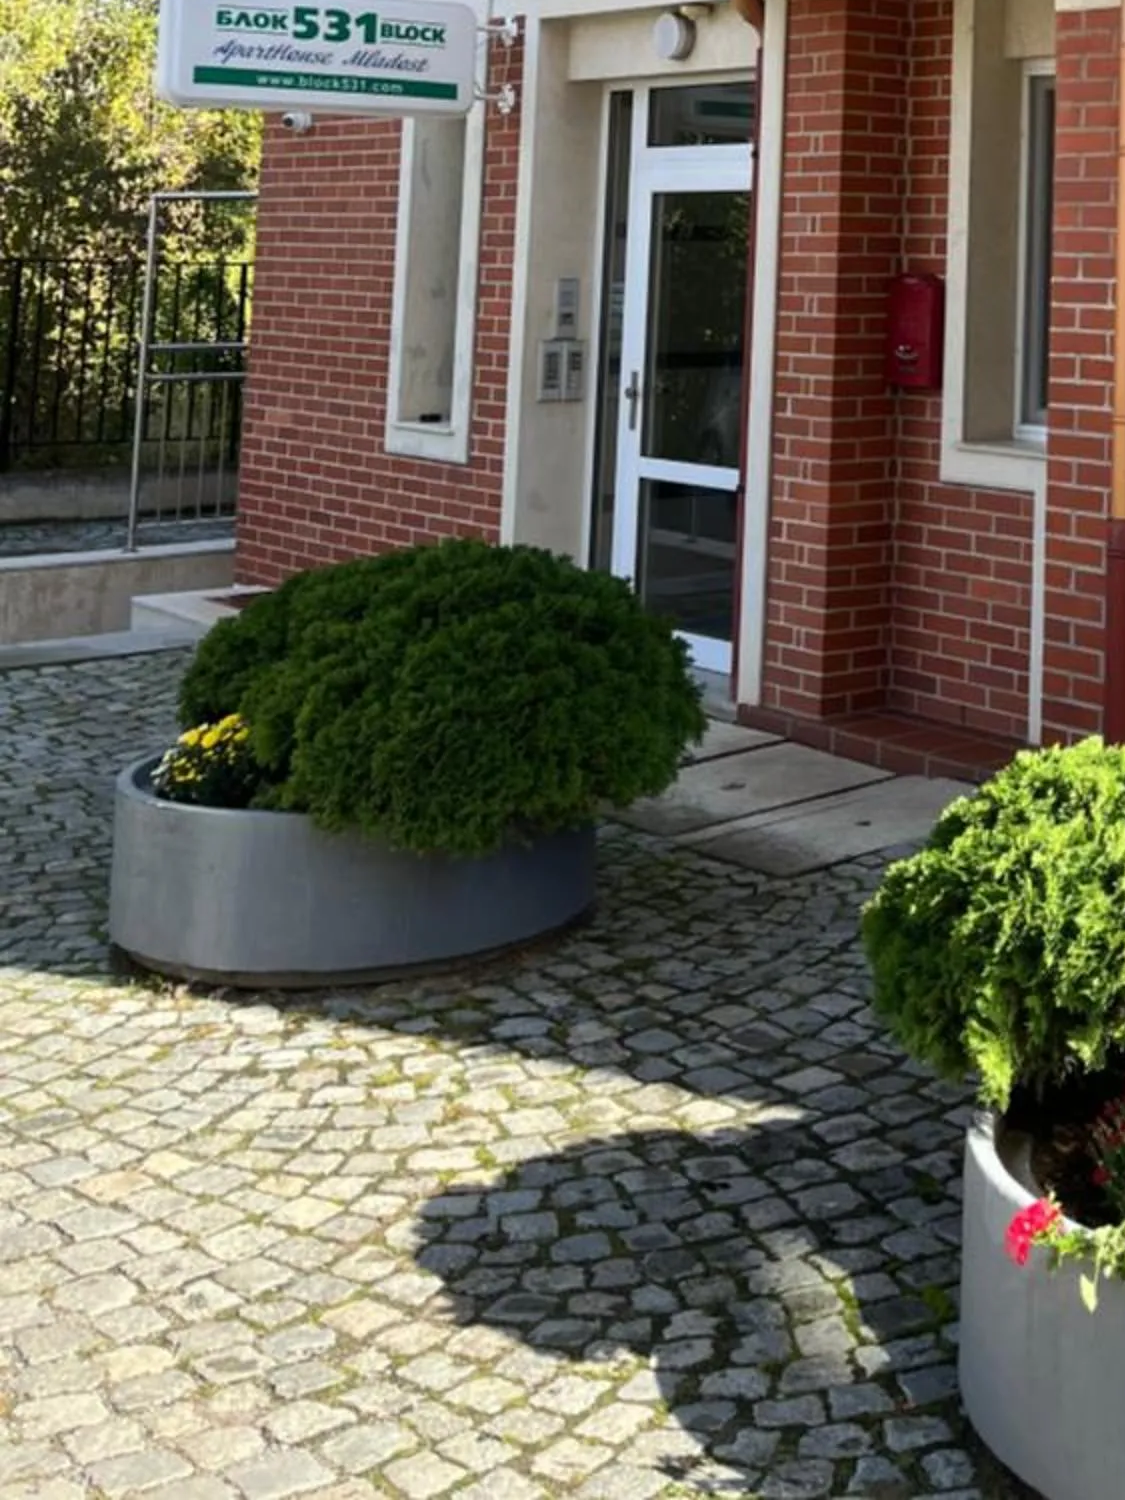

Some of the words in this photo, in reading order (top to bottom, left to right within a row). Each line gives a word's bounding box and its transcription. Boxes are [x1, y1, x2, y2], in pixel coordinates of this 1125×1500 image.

[215, 9, 288, 30] БЛОК
[292, 6, 378, 45] 531
[380, 22, 446, 43] BLOCK
[212, 39, 334, 65] ApartHouse
[341, 50, 430, 73] Mladost
[255, 73, 404, 93] www.block531.com
